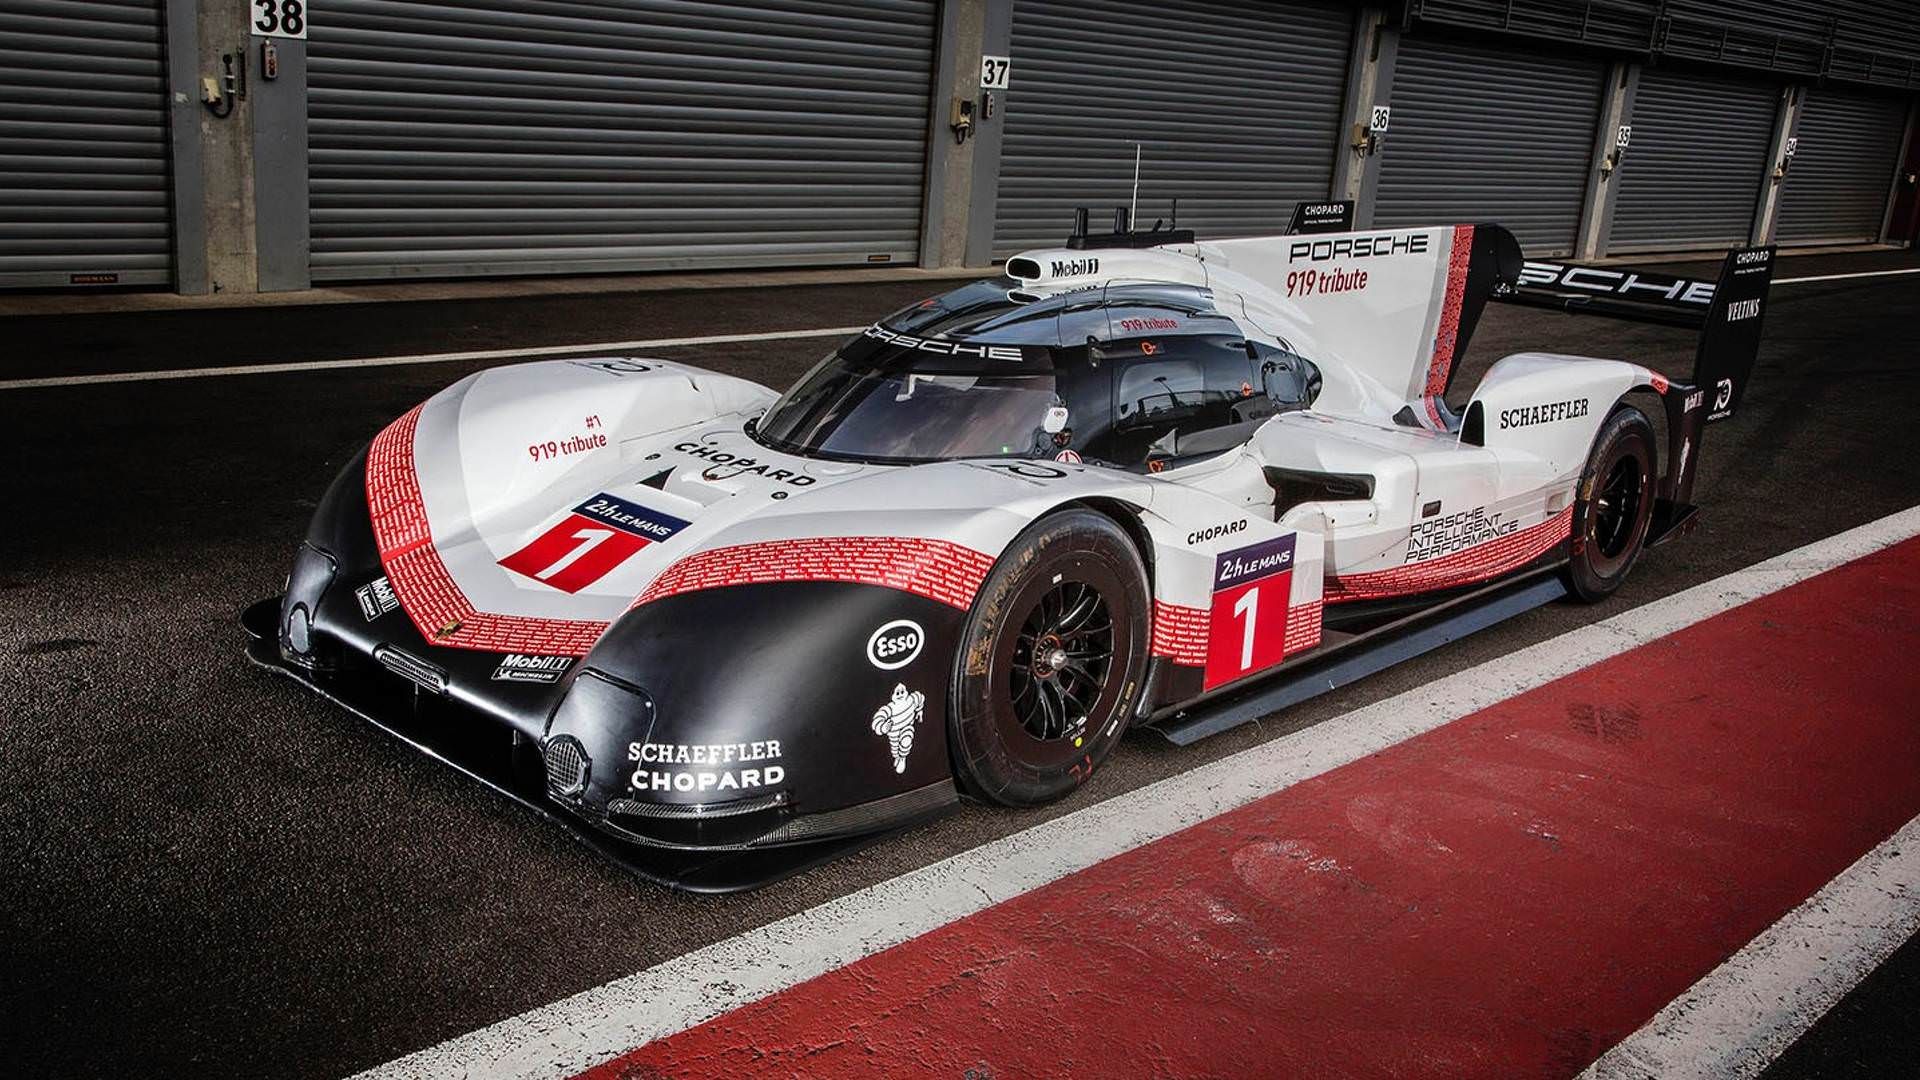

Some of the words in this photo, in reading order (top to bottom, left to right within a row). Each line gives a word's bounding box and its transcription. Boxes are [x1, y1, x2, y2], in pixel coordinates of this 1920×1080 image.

[255, 0, 303, 35] 38
[983, 59, 1008, 85] 37
[1373, 109, 1388, 128] 36
[1617, 127, 1630, 144] 35
[1304, 204, 1345, 216] CHOPARD
[1289, 234, 1429, 264] PORSCHE
[1736, 250, 1769, 265] CHOPARD
[1287, 268, 1317, 298] 919
[1318, 267, 1368, 294] tribute
[1727, 298, 1760, 322] VELTINS
[1121, 319, 1143, 331] 919
[1143, 317, 1178, 330] tribute
[585, 415, 602, 428] #1
[1500, 398, 1589, 429] SCHAEFFLER
[528, 441, 558, 462] 919
[560, 433, 607, 455] tribute
[674, 442, 817, 486] CHOPARD
[628, 518, 672, 536] MANS
[1187, 519, 1248, 545] CHOPARD
[1408, 512, 1503, 551] INTELLIGENT
[1411, 506, 1485, 537] PORSCHE
[534, 528, 616, 580] 1
[1404, 519, 1519, 564] PERFORMANCE
[1259, 550, 1291, 571] MANS
[1233, 586, 1259, 671] 1
[501, 654, 554, 669] Mobil
[628, 740, 783, 765] SCHAEFFLER
[631, 766, 785, 792] CHOPARD
